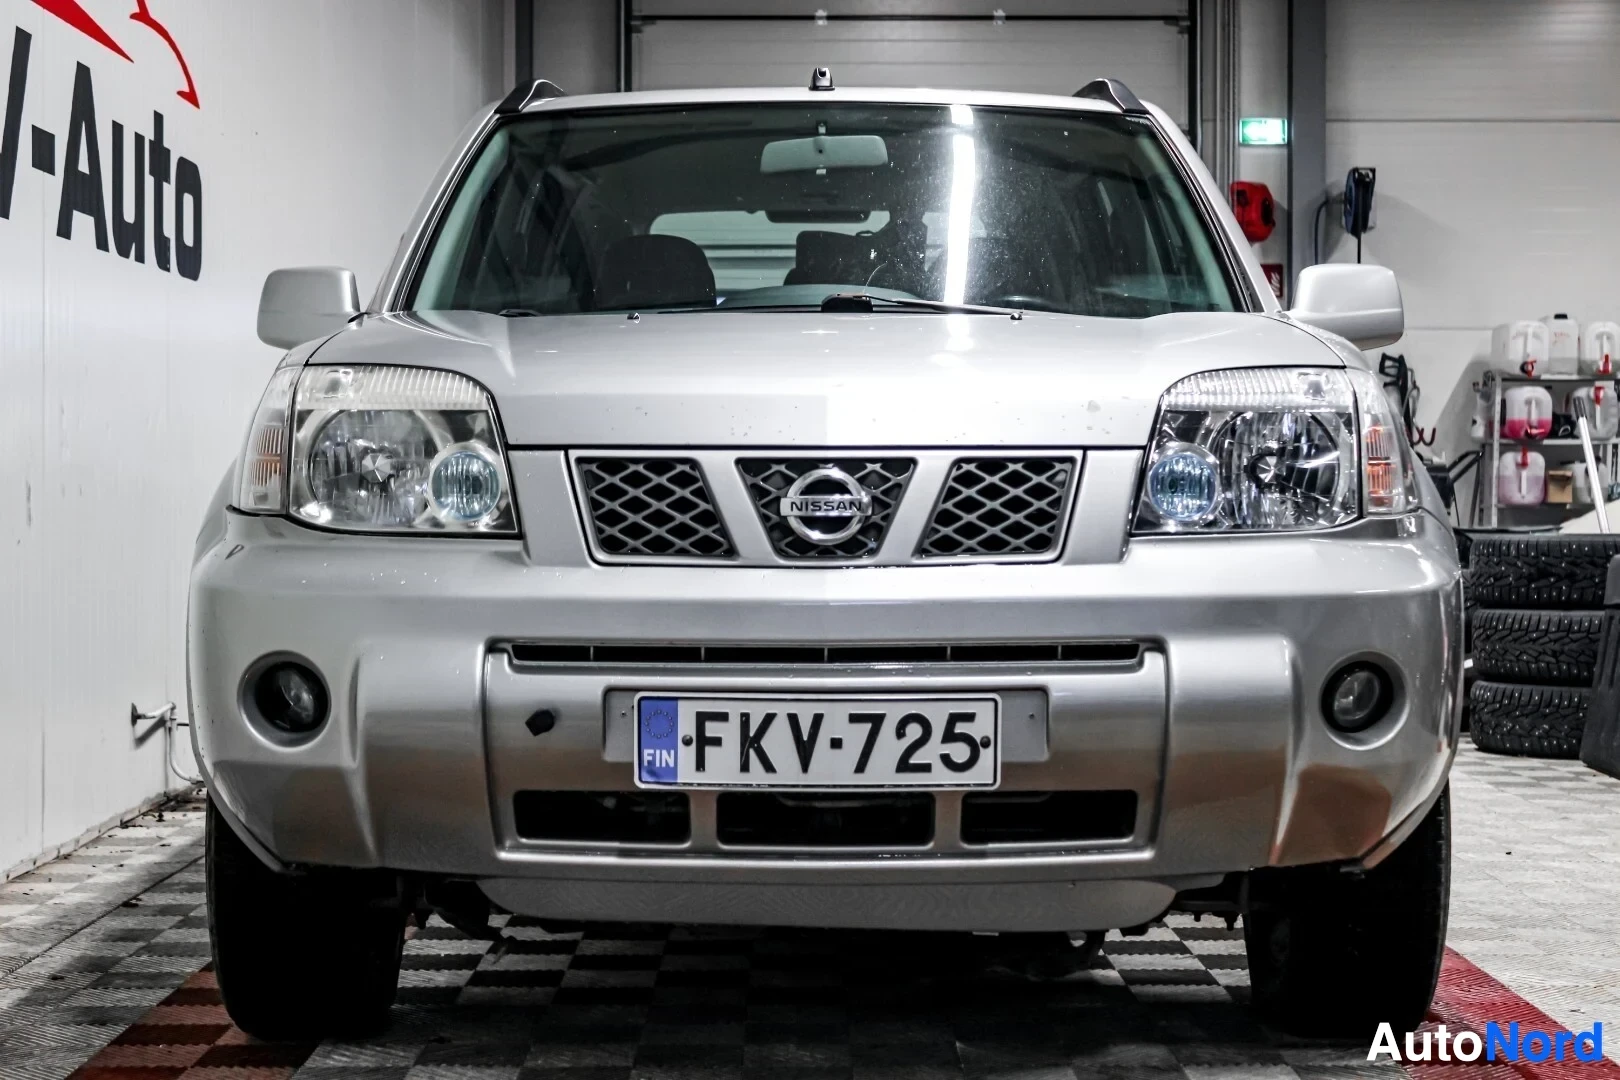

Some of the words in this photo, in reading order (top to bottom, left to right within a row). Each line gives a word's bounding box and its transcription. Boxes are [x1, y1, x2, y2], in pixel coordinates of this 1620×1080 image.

[790, 501, 861, 512] NISSAN
[695, 711, 981, 773] FKV-725
[643, 749, 675, 768] FIN
